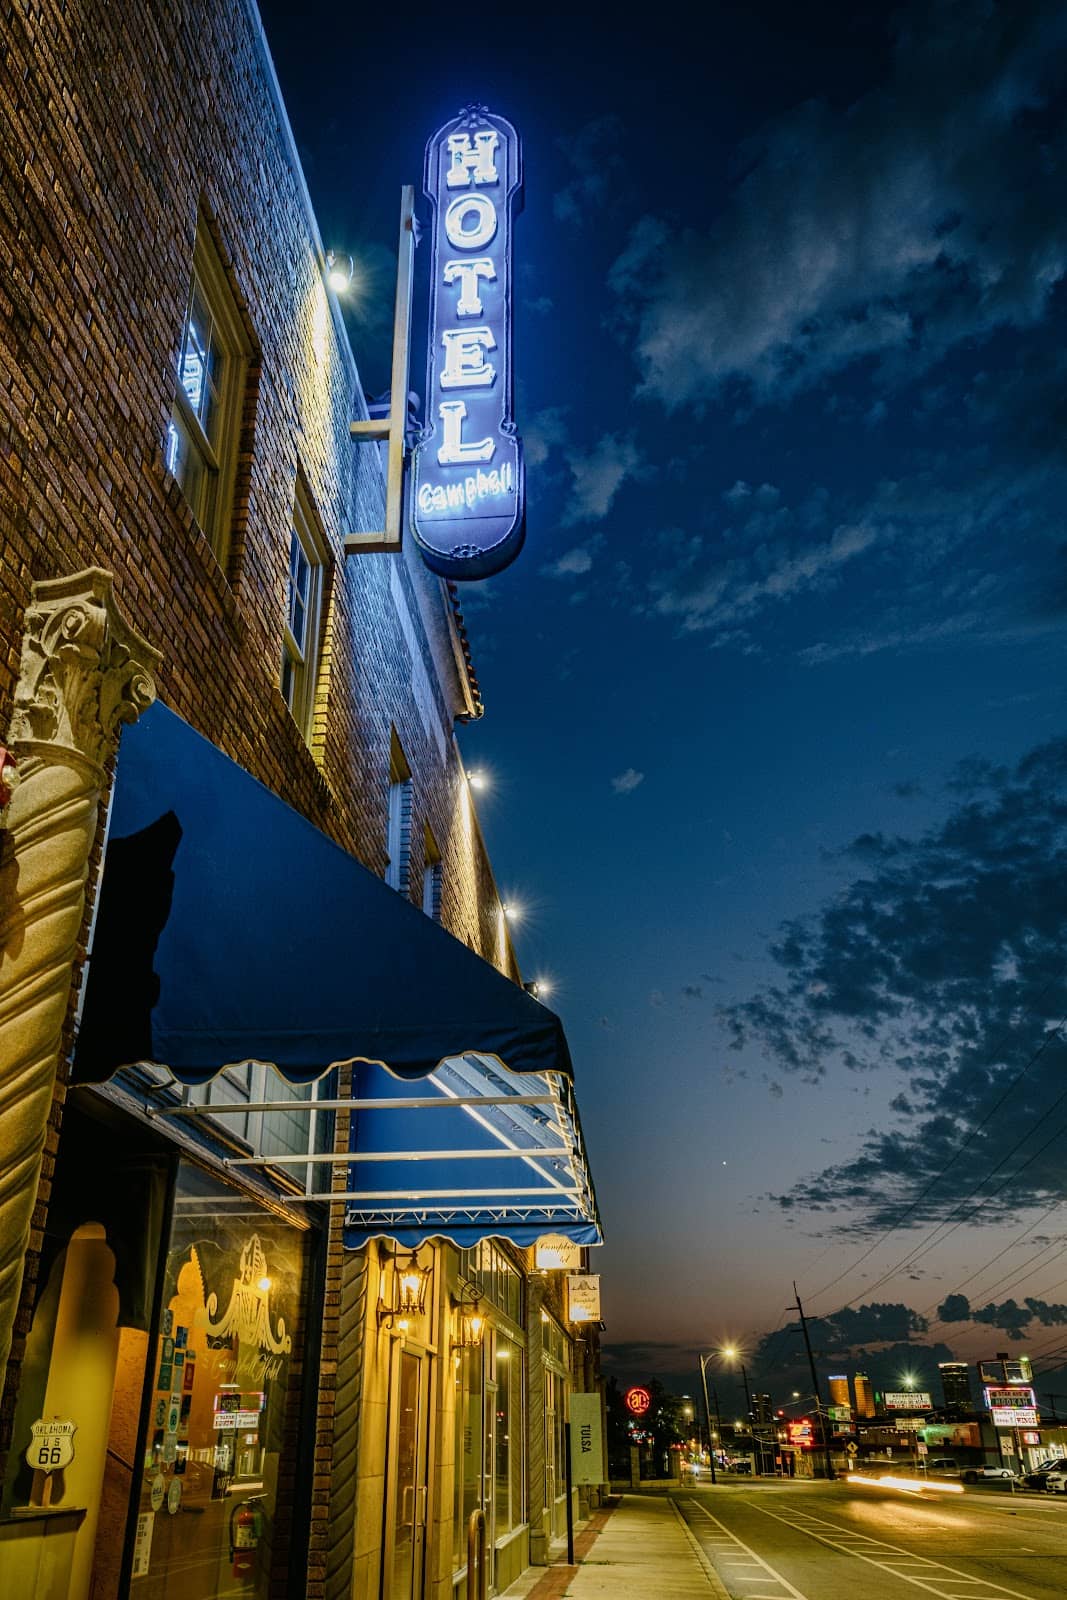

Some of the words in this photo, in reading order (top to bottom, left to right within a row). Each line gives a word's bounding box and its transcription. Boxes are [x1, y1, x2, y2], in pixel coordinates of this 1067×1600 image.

[437, 131, 499, 467] HOTEL
[419, 462, 512, 515] Campbell
[35, 1425, 71, 1435] OKLAHOMA
[580, 1424, 592, 1453] TULSA
[38, 1447, 61, 1465] 66
